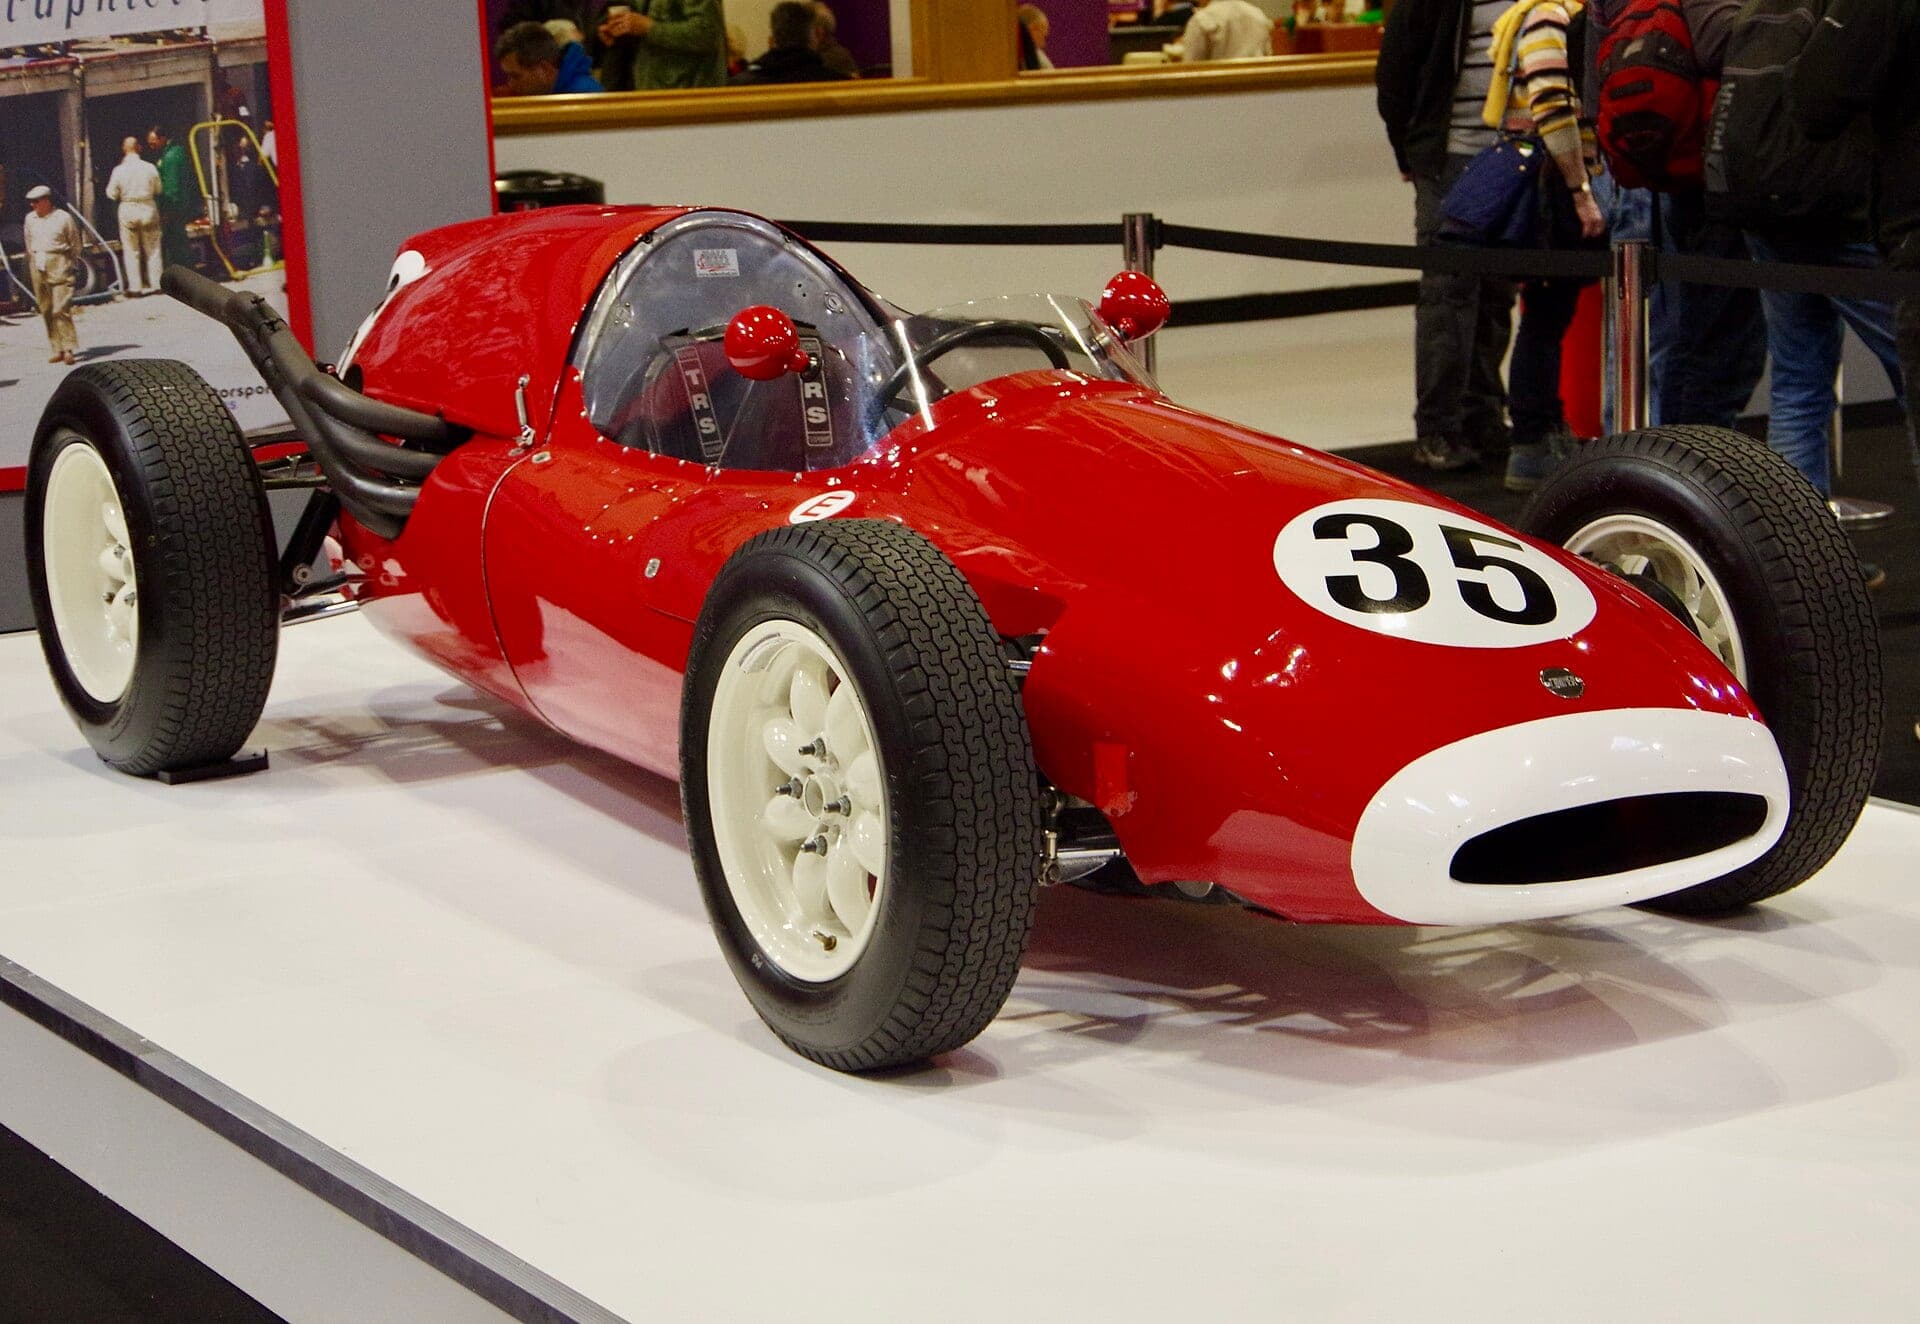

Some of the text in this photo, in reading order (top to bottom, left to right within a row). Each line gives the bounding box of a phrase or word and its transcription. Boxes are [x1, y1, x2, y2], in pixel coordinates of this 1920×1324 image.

[684, 368, 716, 434] TRS
[804, 382, 828, 424] RS
[800, 496, 846, 517] E
[1312, 513, 1558, 626] 35
